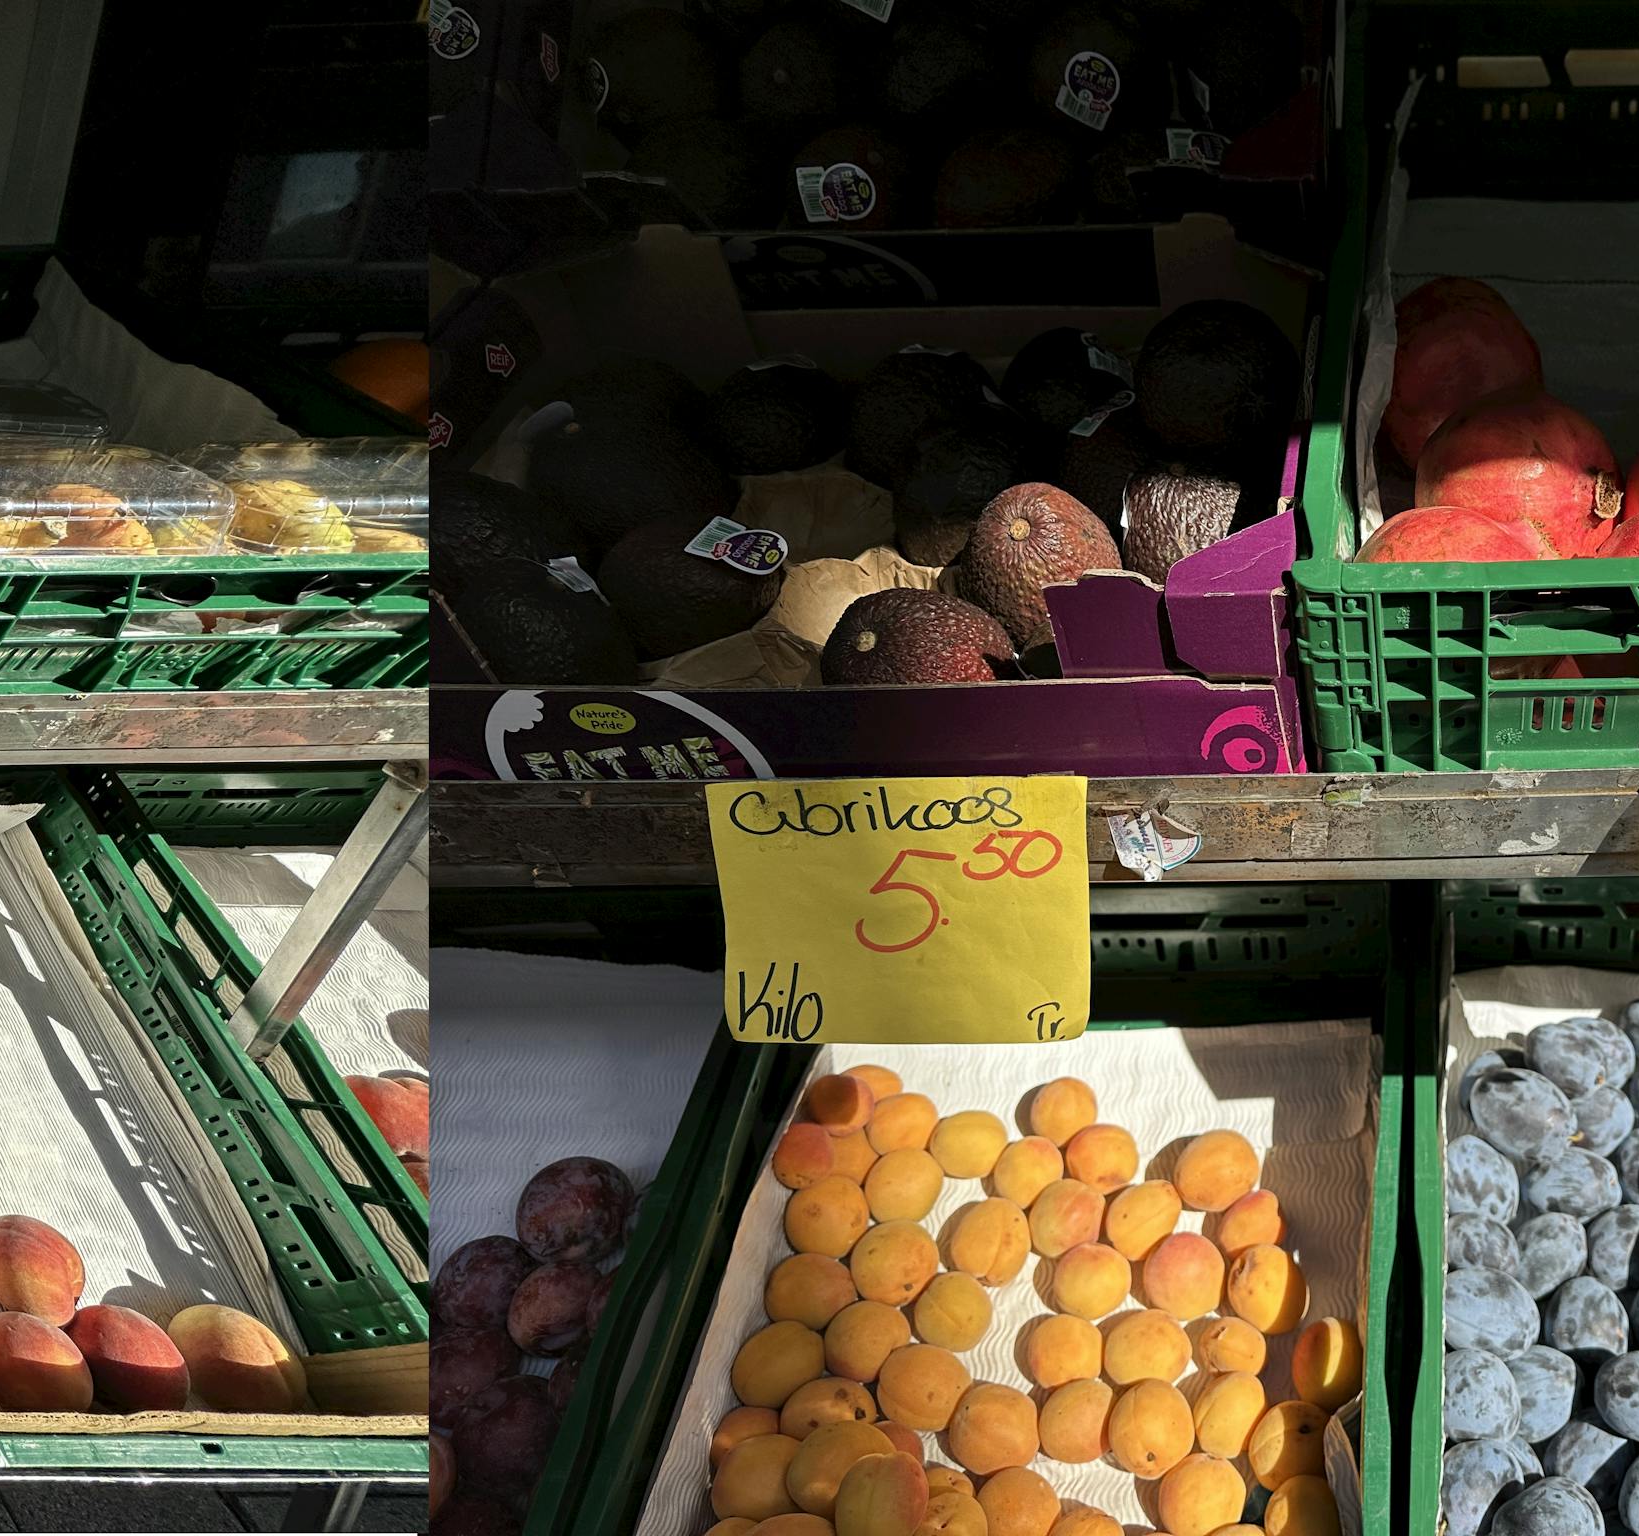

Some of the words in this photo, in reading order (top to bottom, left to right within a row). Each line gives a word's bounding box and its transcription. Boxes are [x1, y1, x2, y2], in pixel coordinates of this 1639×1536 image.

[575, 708, 627, 721] Nature's
[590, 719, 624, 731] Pride
[738, 962, 825, 1043] Kilo
